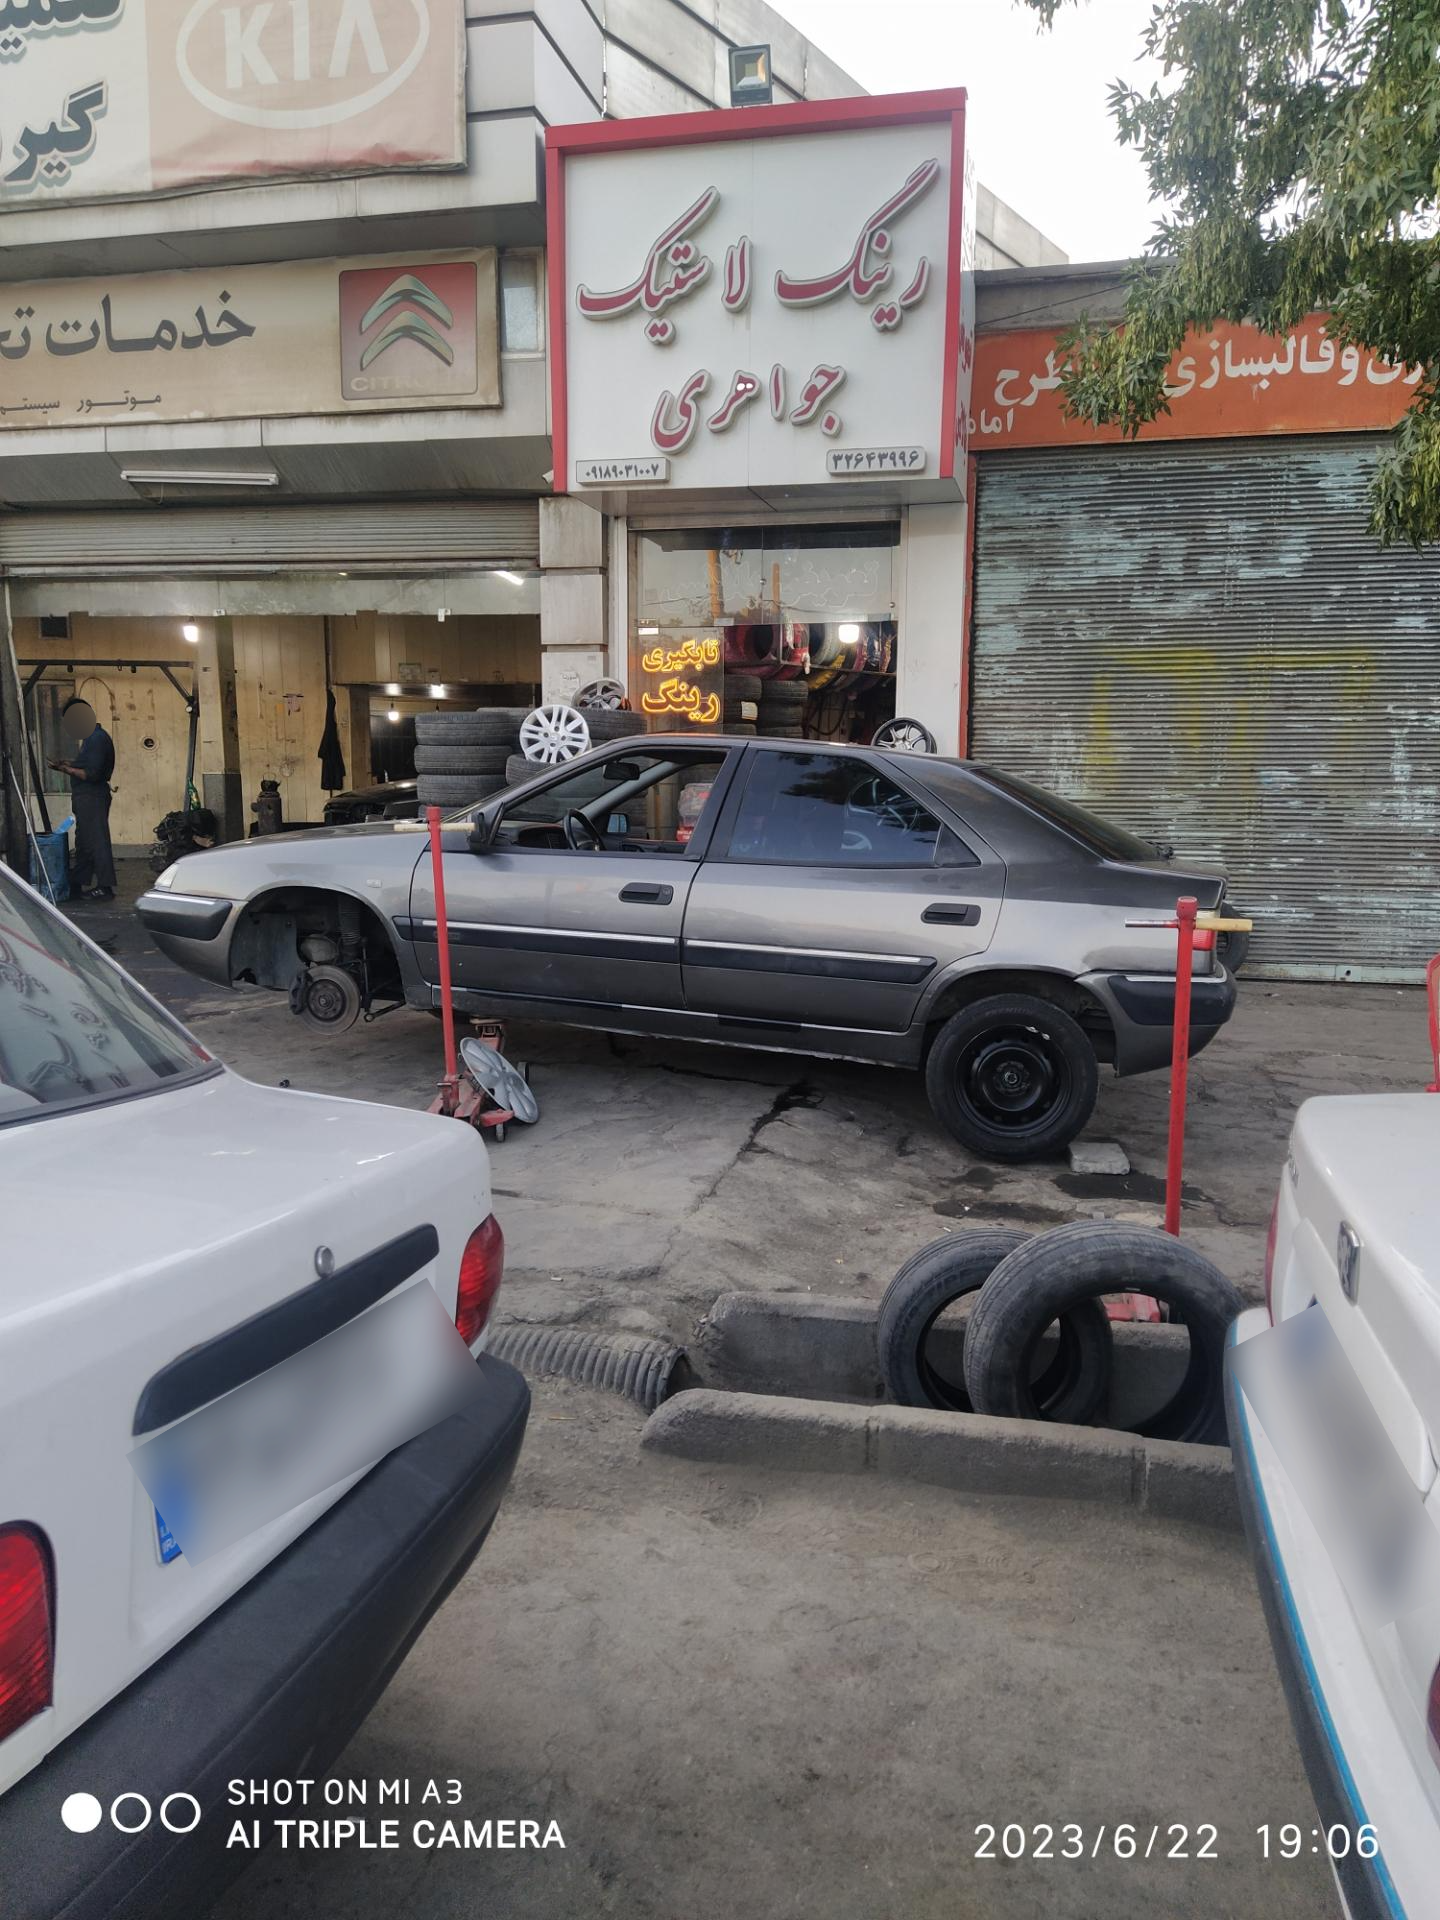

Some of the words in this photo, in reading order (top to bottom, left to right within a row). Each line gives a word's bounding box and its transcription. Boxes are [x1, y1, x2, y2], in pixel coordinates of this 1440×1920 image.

[221, 0, 389, 89] KIA
[0, 79, 106, 186] گیر
[576, 186, 753, 345] لاستیک
[774, 158, 940, 332] رینگ
[46, 290, 256, 356] خدمات
[77, 391, 161, 412] موتور
[651, 363, 847, 454] جواهری
[585, 463, 660, 480] ۰۹۱۸۹۰۳۱۰۰۷
[832, 450, 920, 471] ۳۲۶۴۳۹۹۶
